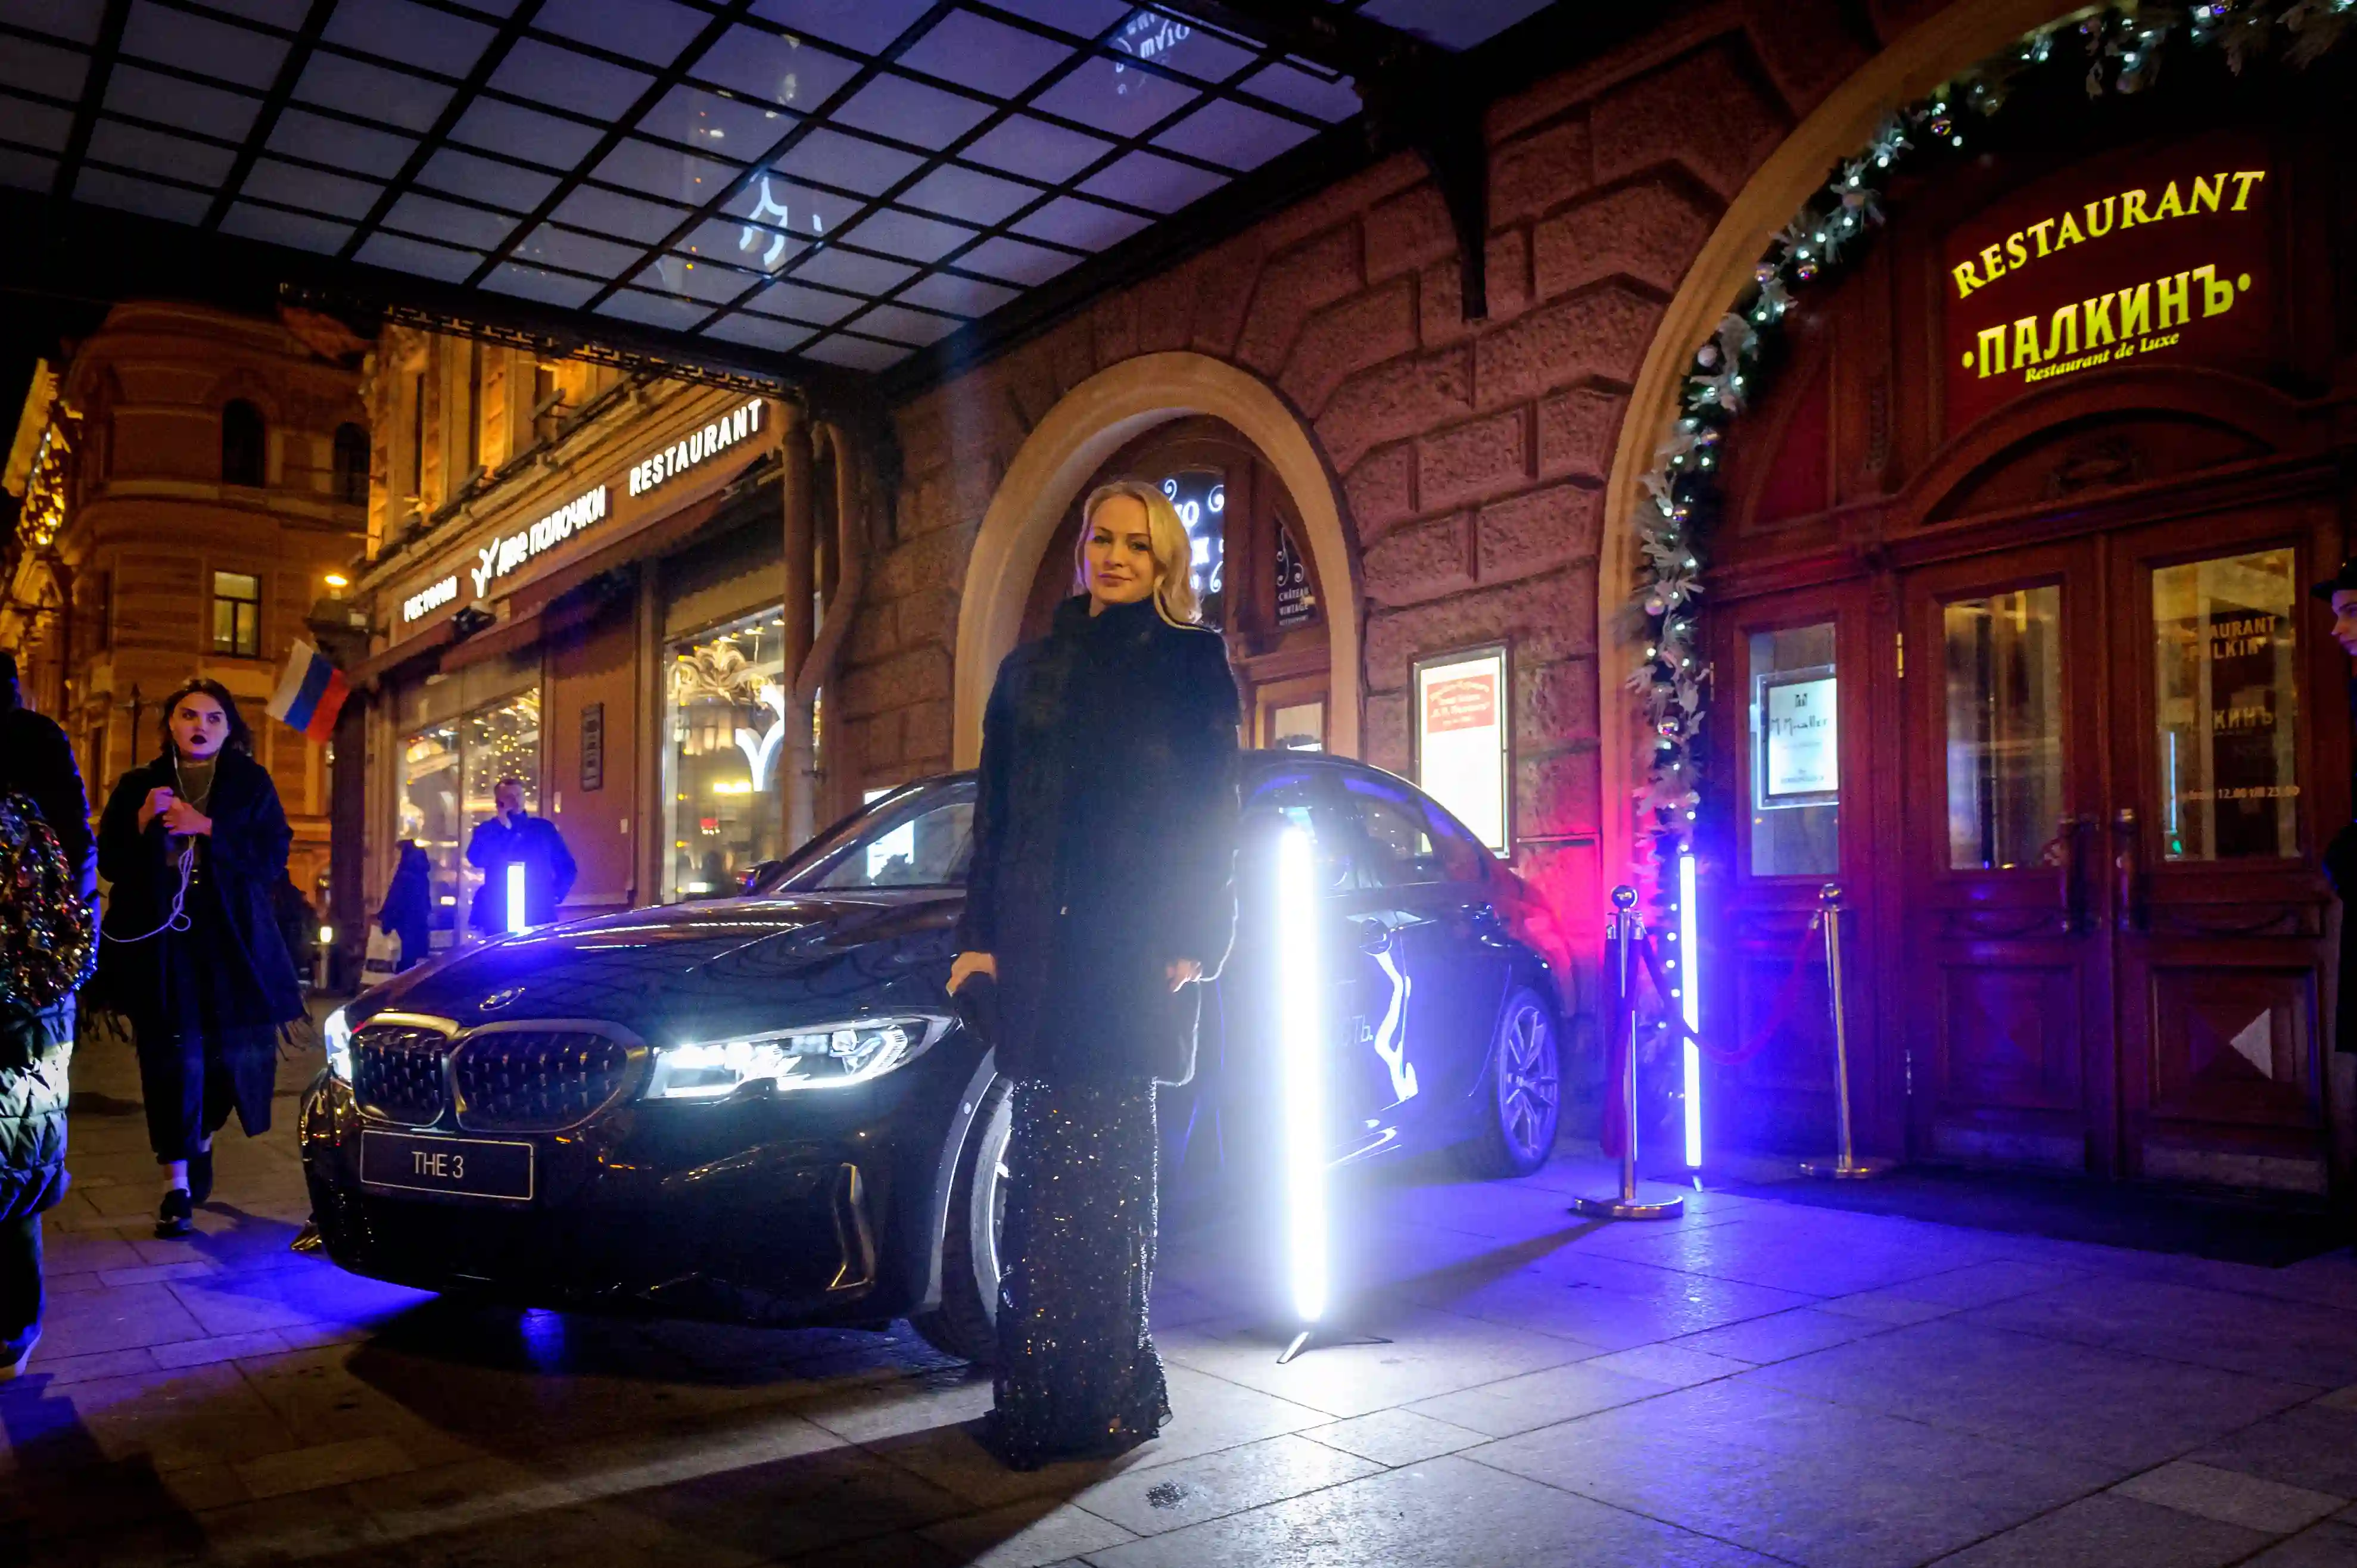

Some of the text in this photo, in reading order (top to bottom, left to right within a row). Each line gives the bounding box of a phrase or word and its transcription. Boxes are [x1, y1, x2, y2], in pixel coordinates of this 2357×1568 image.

[1951, 171, 2265, 298] RESTAURANT
[1977, 264, 2234, 379] ПАЛКИНЪ
[2025, 333, 2179, 383] Restaurant de Luxe
[629, 398, 762, 497] RESTAURANT
[412, 1151, 463, 1179] THE 3
